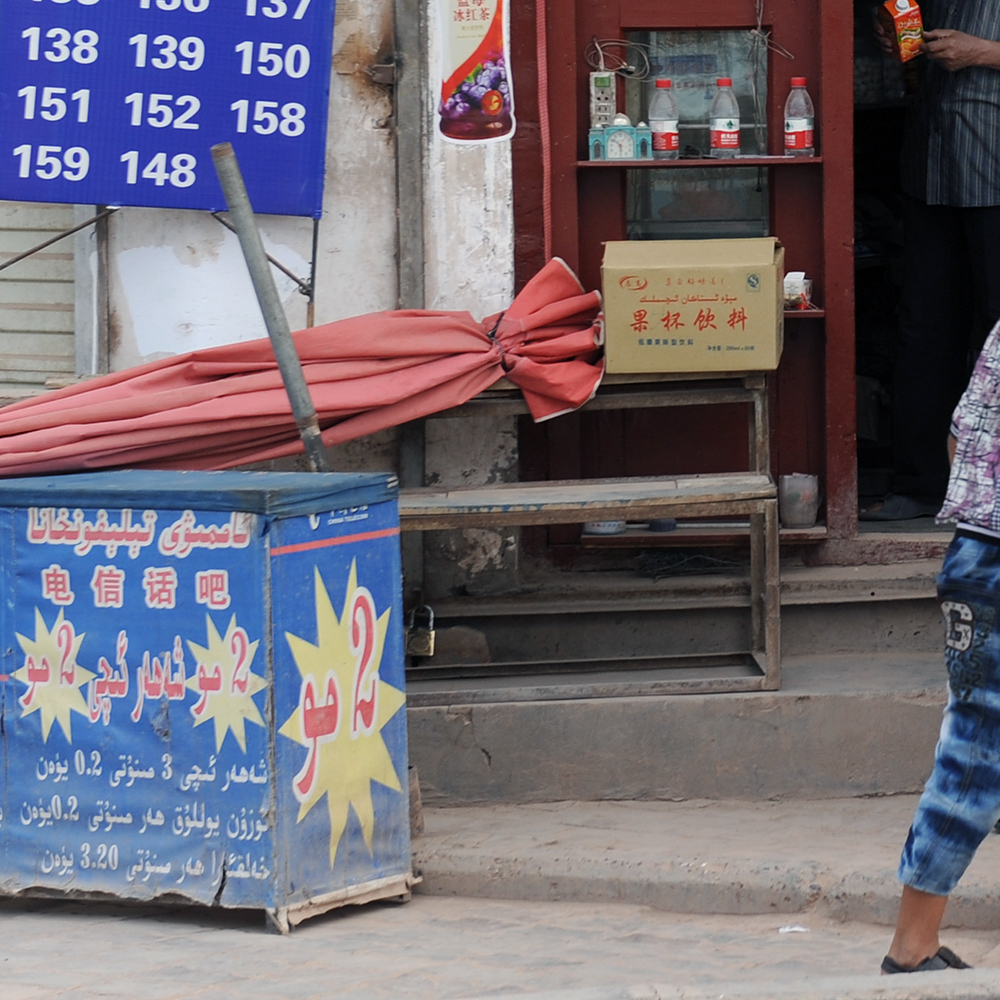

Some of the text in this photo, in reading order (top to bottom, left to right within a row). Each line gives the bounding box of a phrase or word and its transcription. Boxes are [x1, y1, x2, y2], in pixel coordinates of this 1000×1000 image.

[453, 7, 490, 22] 冰红茶
[20, 26, 311, 79] 138 139 150
[17, 85, 307, 137] 151 152 158
[12, 144, 198, 188] 159 148
[630, 307, 748, 334] 果杯饮料
[42, 565, 230, 610] 电信话吧
[57, 621, 76, 686] 2
[231, 628, 250, 694] 2
[20, 656, 50, 706] مو
[190, 663, 223, 716] مو
[74, 749, 103, 777] 0.2
[161, 753, 174, 780] 3
[80, 842, 119, 871] 3.20
